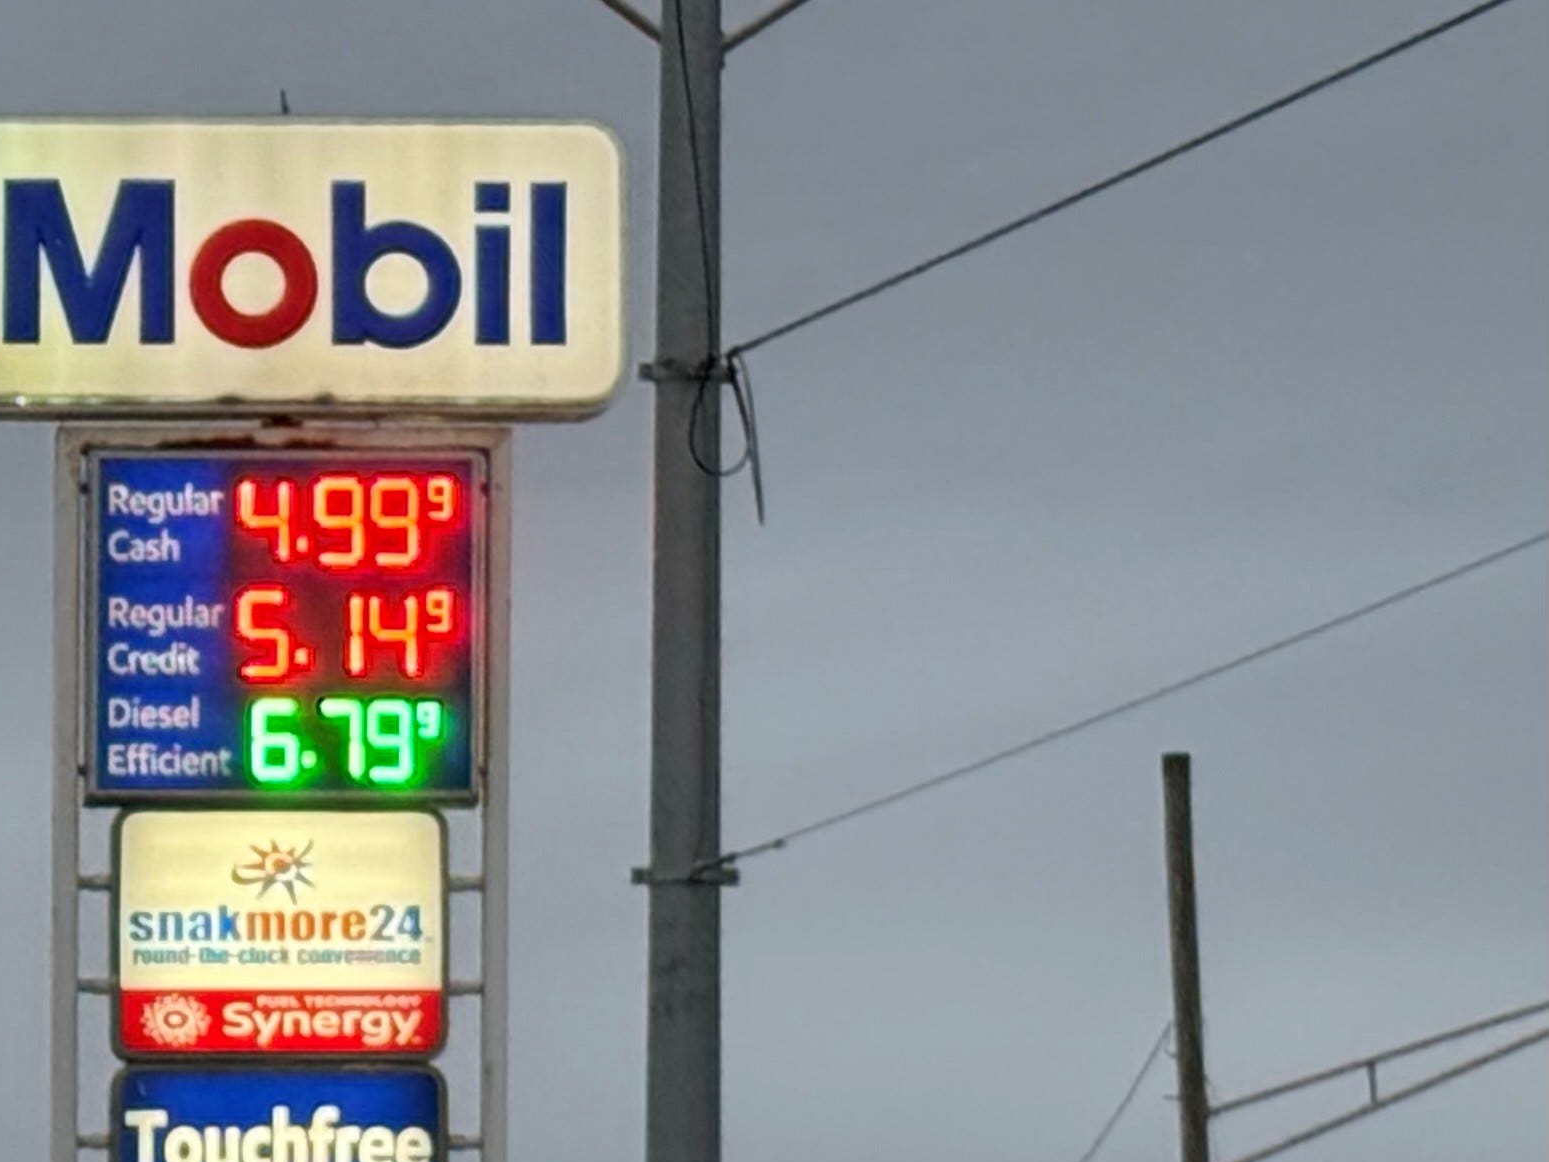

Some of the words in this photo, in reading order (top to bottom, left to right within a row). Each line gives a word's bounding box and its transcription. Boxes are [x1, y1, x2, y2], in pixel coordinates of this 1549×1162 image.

[3, 179, 568, 349] Mobil
[107, 484, 224, 518] Regular
[107, 534, 181, 563] Cash
[107, 597, 224, 630] Regular
[107, 645, 201, 675] Credit
[107, 697, 200, 728] Diesel
[107, 745, 232, 776] Efficient
[129, 904, 423, 942] snakmore24
[221, 1001, 422, 1046] Synergy
